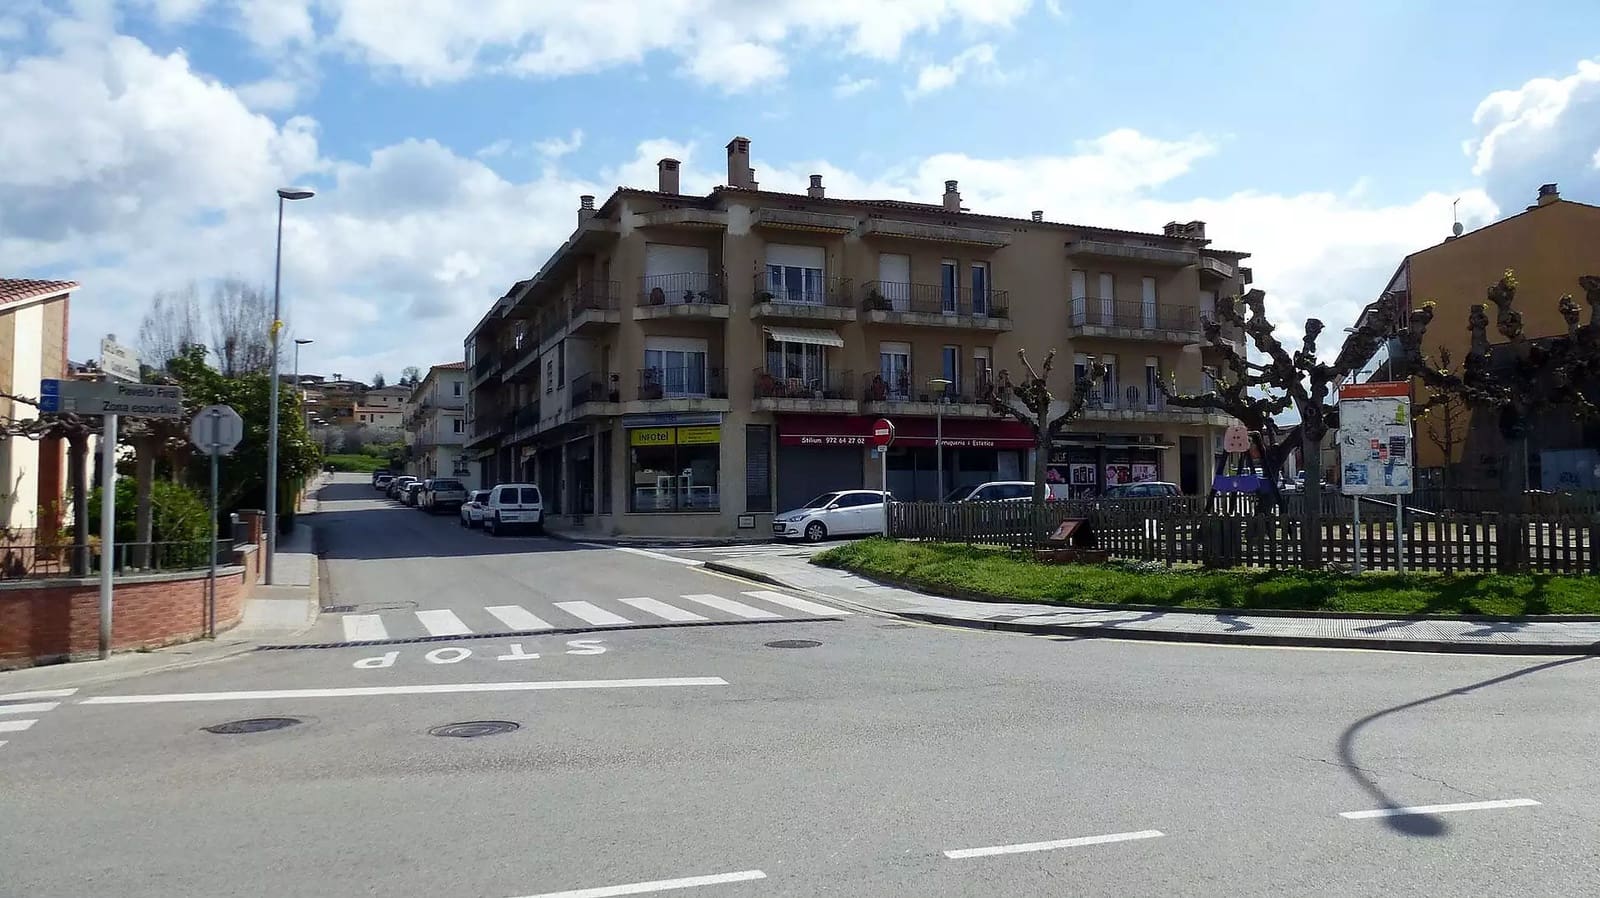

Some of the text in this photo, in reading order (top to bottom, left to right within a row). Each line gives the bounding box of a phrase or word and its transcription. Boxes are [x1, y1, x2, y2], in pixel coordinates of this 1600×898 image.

[103, 400, 177, 415] Zona esportiva
[935, 439, 966, 447] Prruqueria
[353, 638, 607, 669] STOP
